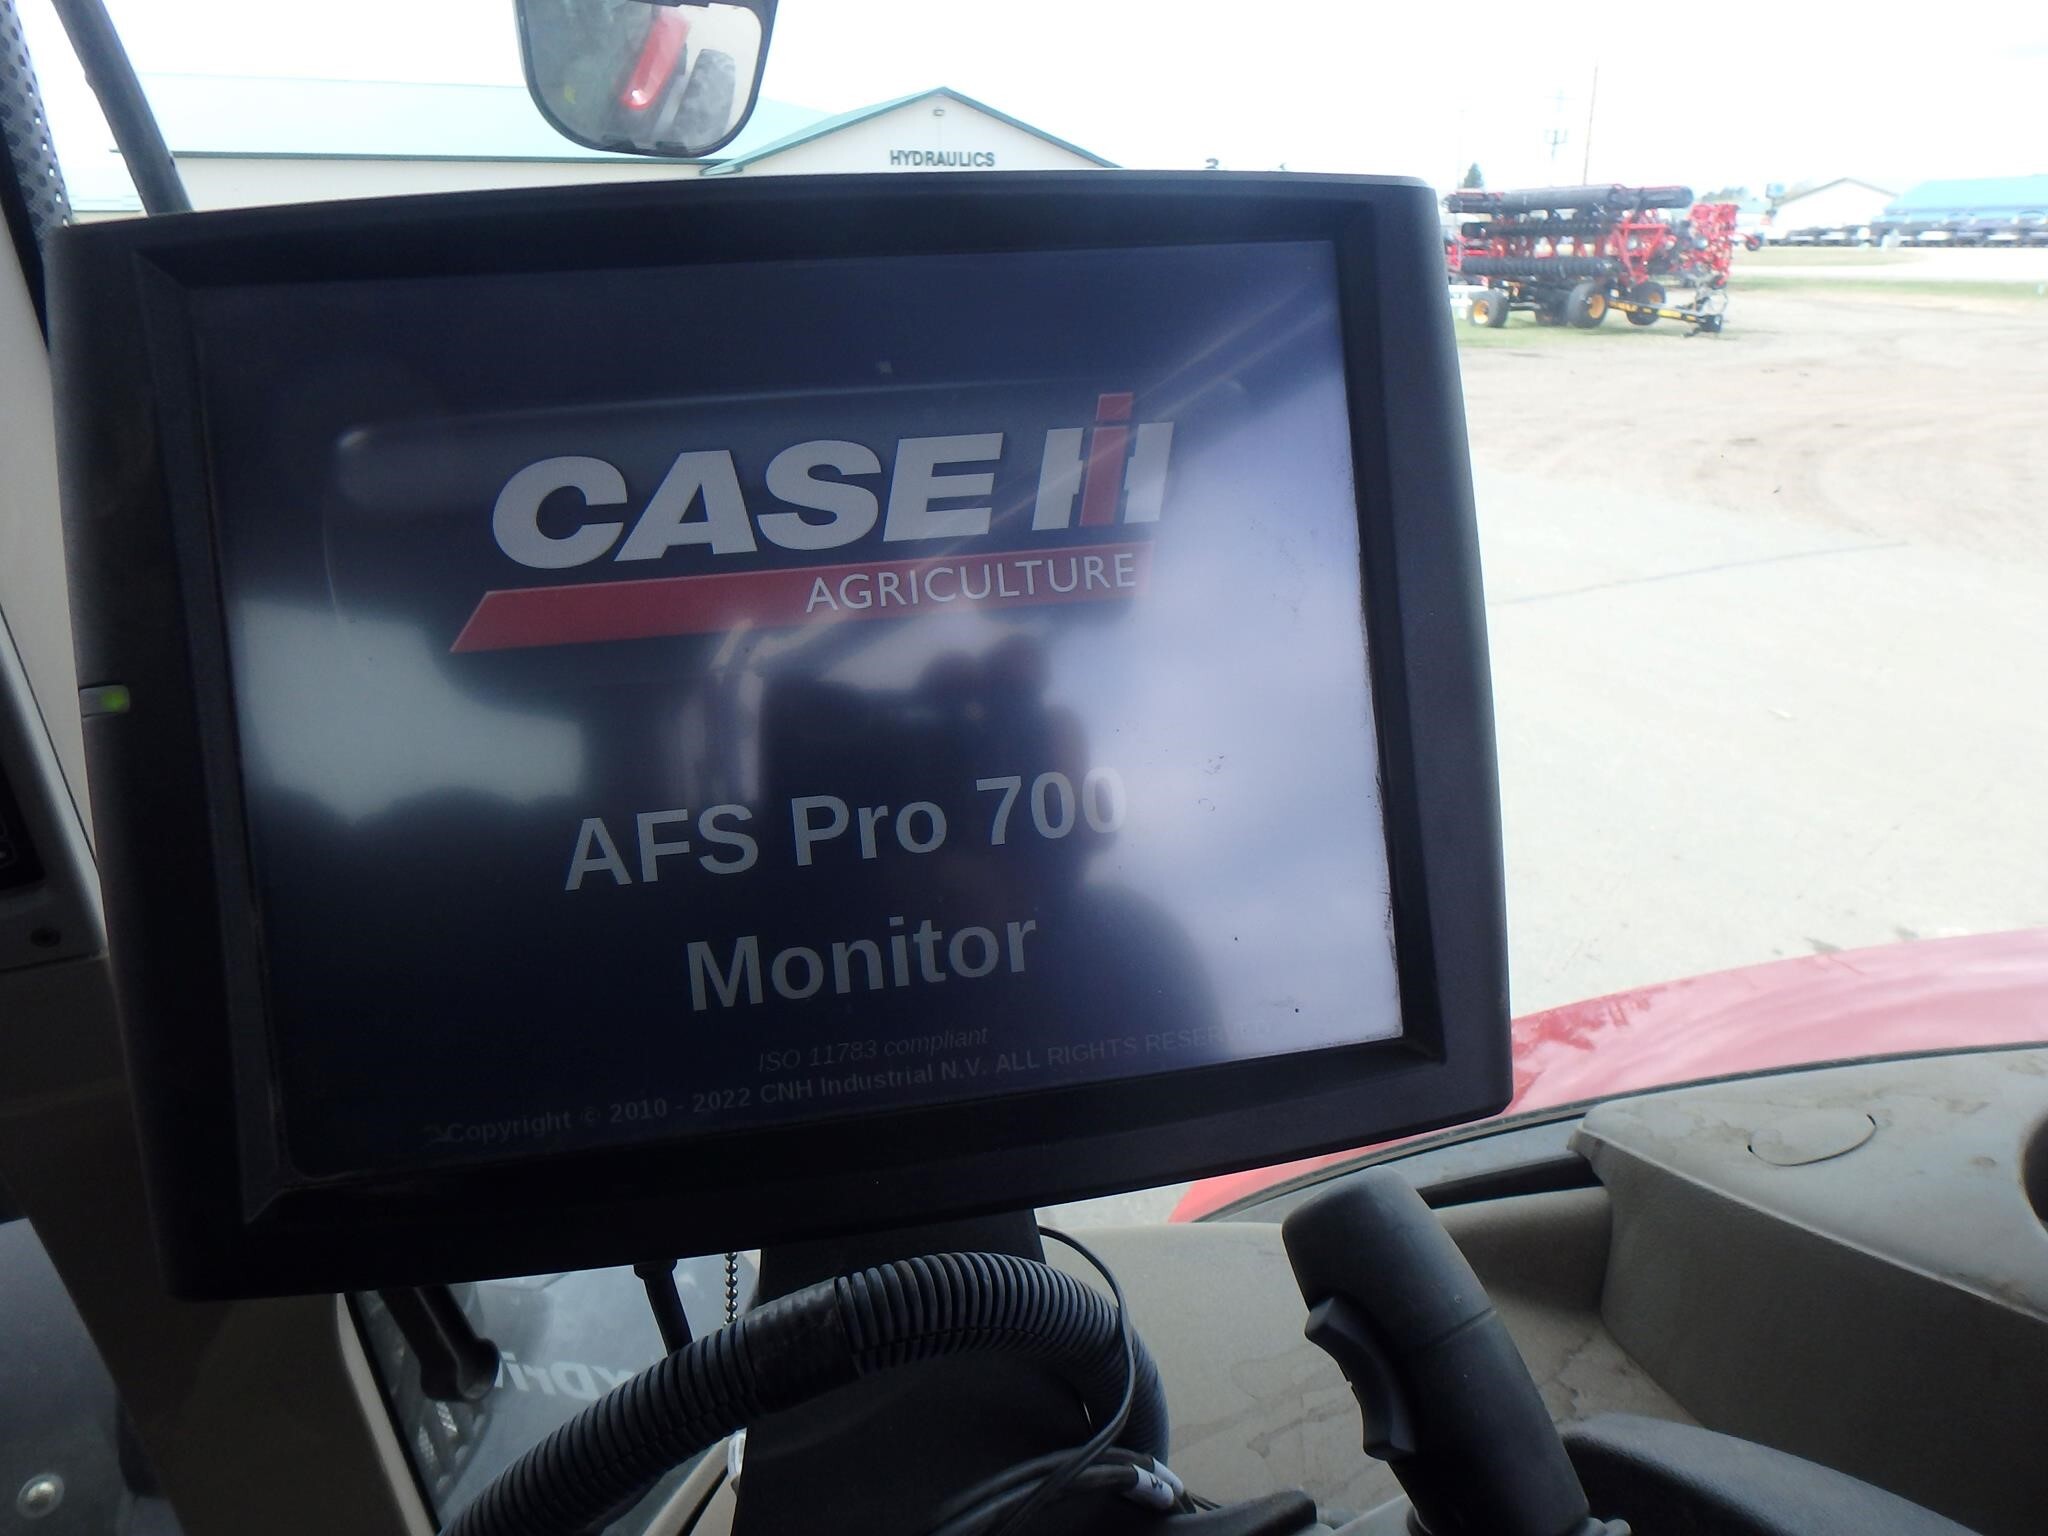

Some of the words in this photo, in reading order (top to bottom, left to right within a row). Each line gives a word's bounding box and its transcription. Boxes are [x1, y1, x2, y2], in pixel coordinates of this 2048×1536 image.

[890, 149, 995, 167] HYDRAULICS
[492, 431, 1004, 569] CASE
[1031, 392, 1174, 531] IH
[805, 552, 1137, 613] AGRICULTURE
[564, 803, 760, 890] AFS
[791, 794, 948, 866] Pro
[975, 766, 1127, 846] 700
[686, 914, 1037, 1012] Monitor
[446, 1110, 572, 1145] Copyright
[608, 1098, 668, 1124] 2010
[692, 1087, 751, 1114] 2022
[760, 1079, 814, 1104] CNH
[820, 1063, 935, 1097] Industrial
[941, 1055, 988, 1081] N.V.
[996, 1052, 1041, 1074] ALL
[1047, 1036, 1138, 1066] RIGHTS
[1145, 1020, 1272, 1053] RESERED
[759, 1049, 801, 1073] ISO
[809, 1039, 879, 1067] 11783
[883, 1026, 989, 1057] compliant
